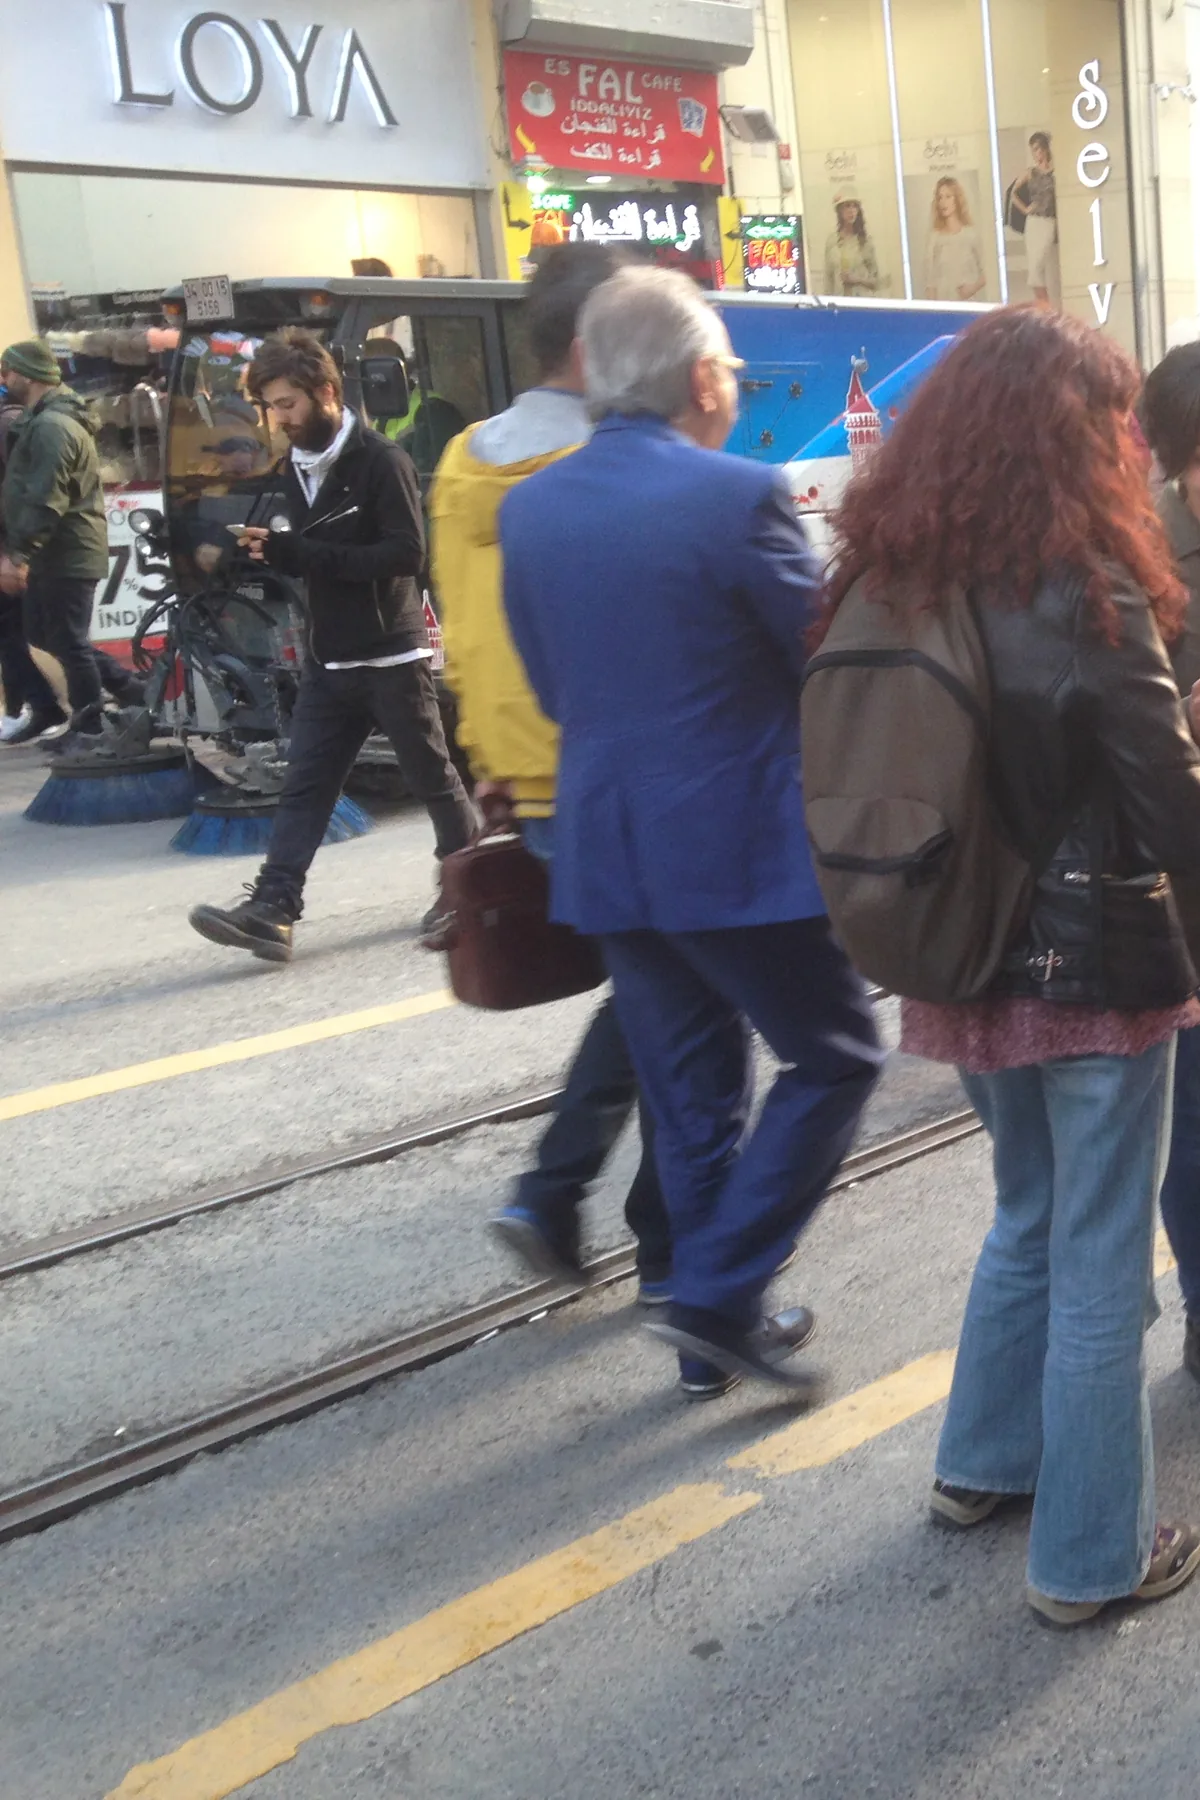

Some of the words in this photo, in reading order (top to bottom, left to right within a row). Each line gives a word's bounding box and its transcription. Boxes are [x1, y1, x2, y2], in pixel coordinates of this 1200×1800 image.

[544, 58, 570, 76] ES
[578, 63, 643, 104] FAL
[642, 72, 683, 92] CAFE
[748, 239, 797, 268] FAL
